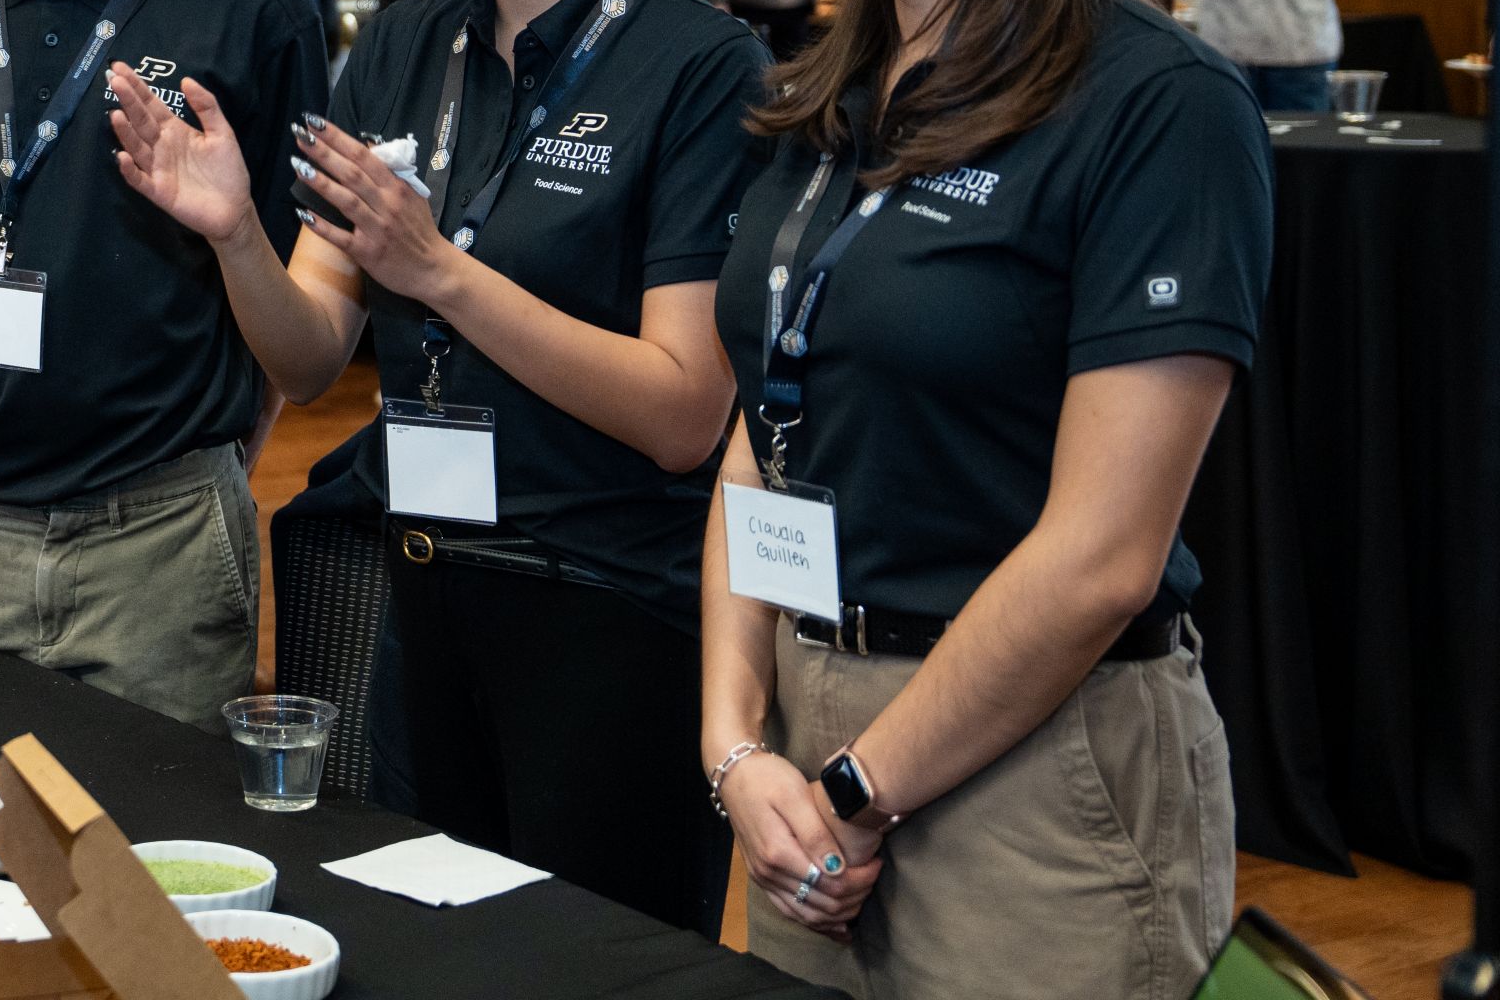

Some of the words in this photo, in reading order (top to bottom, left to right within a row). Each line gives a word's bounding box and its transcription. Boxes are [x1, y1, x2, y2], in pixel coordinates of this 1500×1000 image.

[558, 112, 609, 138] P
[525, 152, 609, 175] UNIVERSITY
[529, 137, 613, 164] PURDUE
[534, 178, 554, 190] Food
[553, 182, 583, 195] Science
[910, 176, 987, 205] NIVERSITY
[749, 516, 805, 544] Claudia
[757, 541, 810, 570] Guillen
